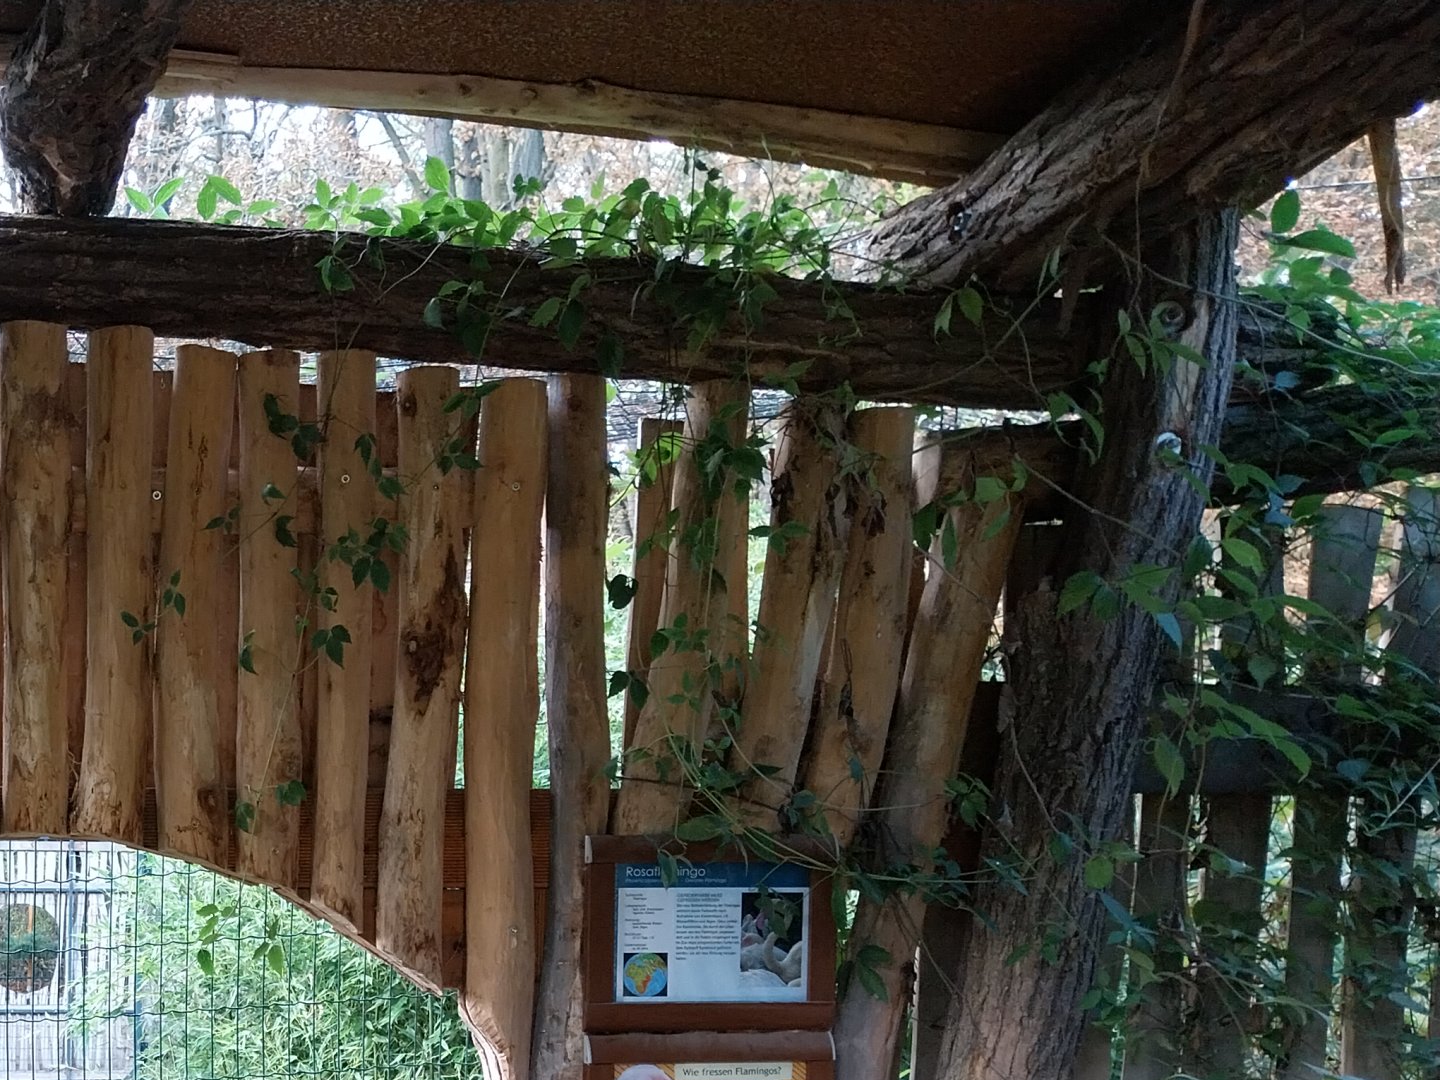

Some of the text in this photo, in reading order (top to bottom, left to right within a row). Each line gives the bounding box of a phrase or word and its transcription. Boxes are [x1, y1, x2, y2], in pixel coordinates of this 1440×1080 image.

[626, 866, 706, 879] Rosaflingo
[683, 1066, 782, 1078] Wie fressen Flamingos?
